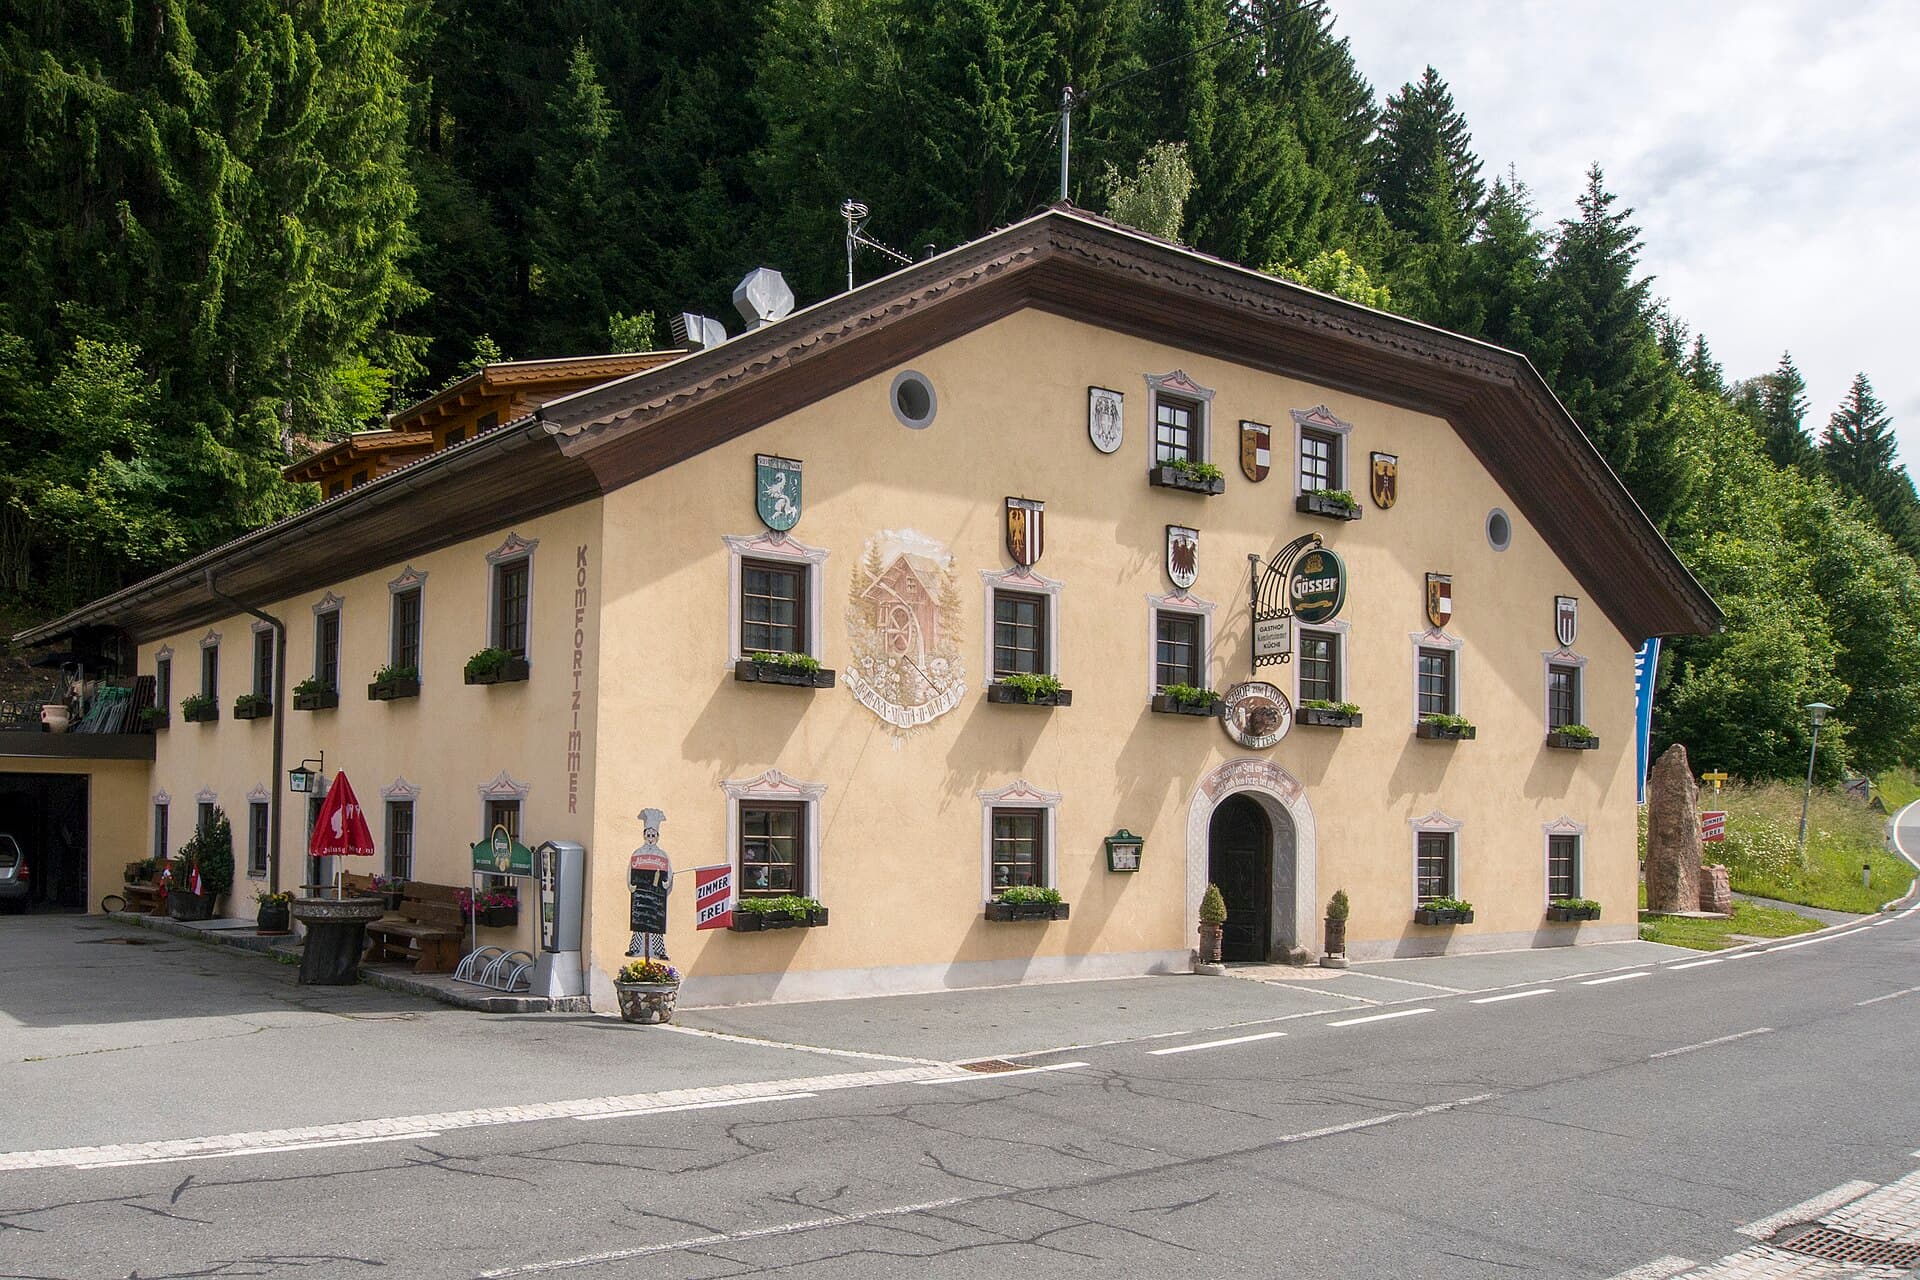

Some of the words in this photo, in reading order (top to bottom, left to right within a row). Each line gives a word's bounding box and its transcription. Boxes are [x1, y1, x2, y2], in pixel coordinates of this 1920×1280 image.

[1291, 574, 1338, 599] Gösser
[567, 544, 587, 813] KOMFORTZIMMER
[698, 876, 728, 899] ZIMMER
[701, 902, 724, 921] FREI
